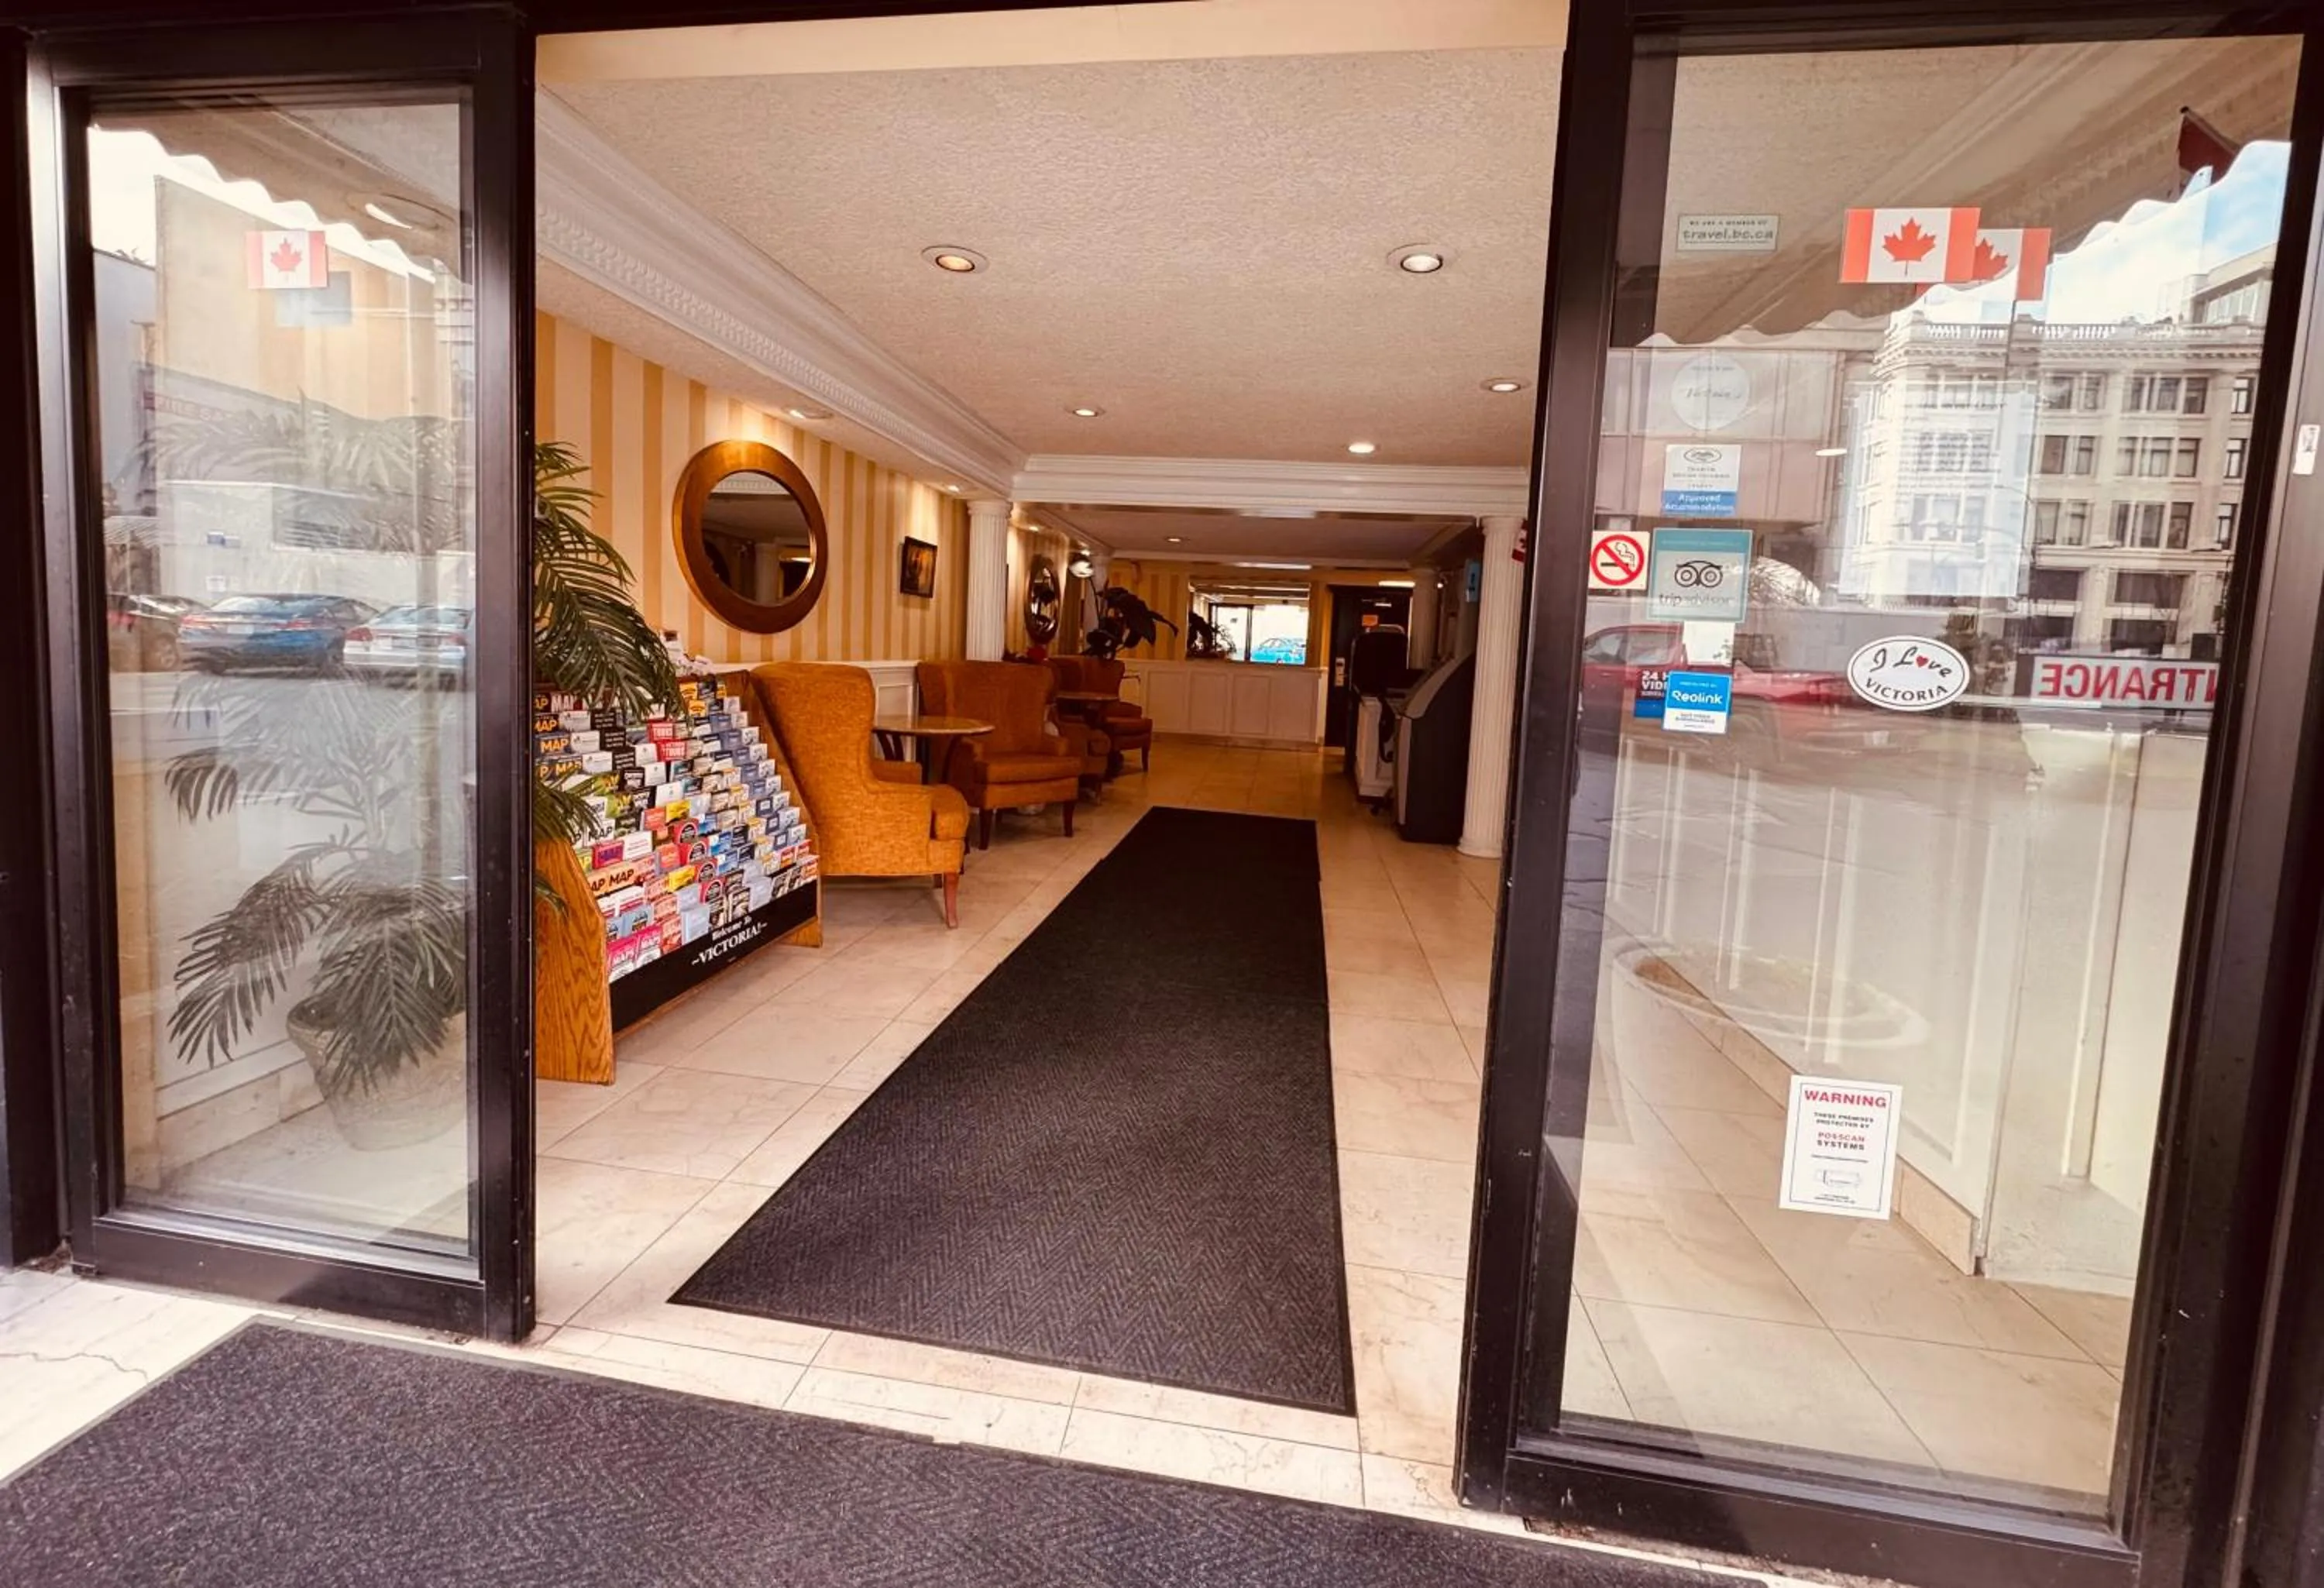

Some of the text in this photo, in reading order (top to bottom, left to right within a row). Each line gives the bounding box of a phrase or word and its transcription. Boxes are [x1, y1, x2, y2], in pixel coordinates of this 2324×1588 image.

[1683, 228, 1774, 240] travel.bc.ca
[1869, 647, 1887, 673] I
[1642, 670, 1659, 681] 24
[1865, 677, 1948, 701] VICTORIA
[541, 738, 569, 753] MAP
[591, 869, 634, 892] AP MAP
[1804, 1089, 1887, 1108] WARNING
[1817, 1139, 1865, 1151] SYSTEMS
